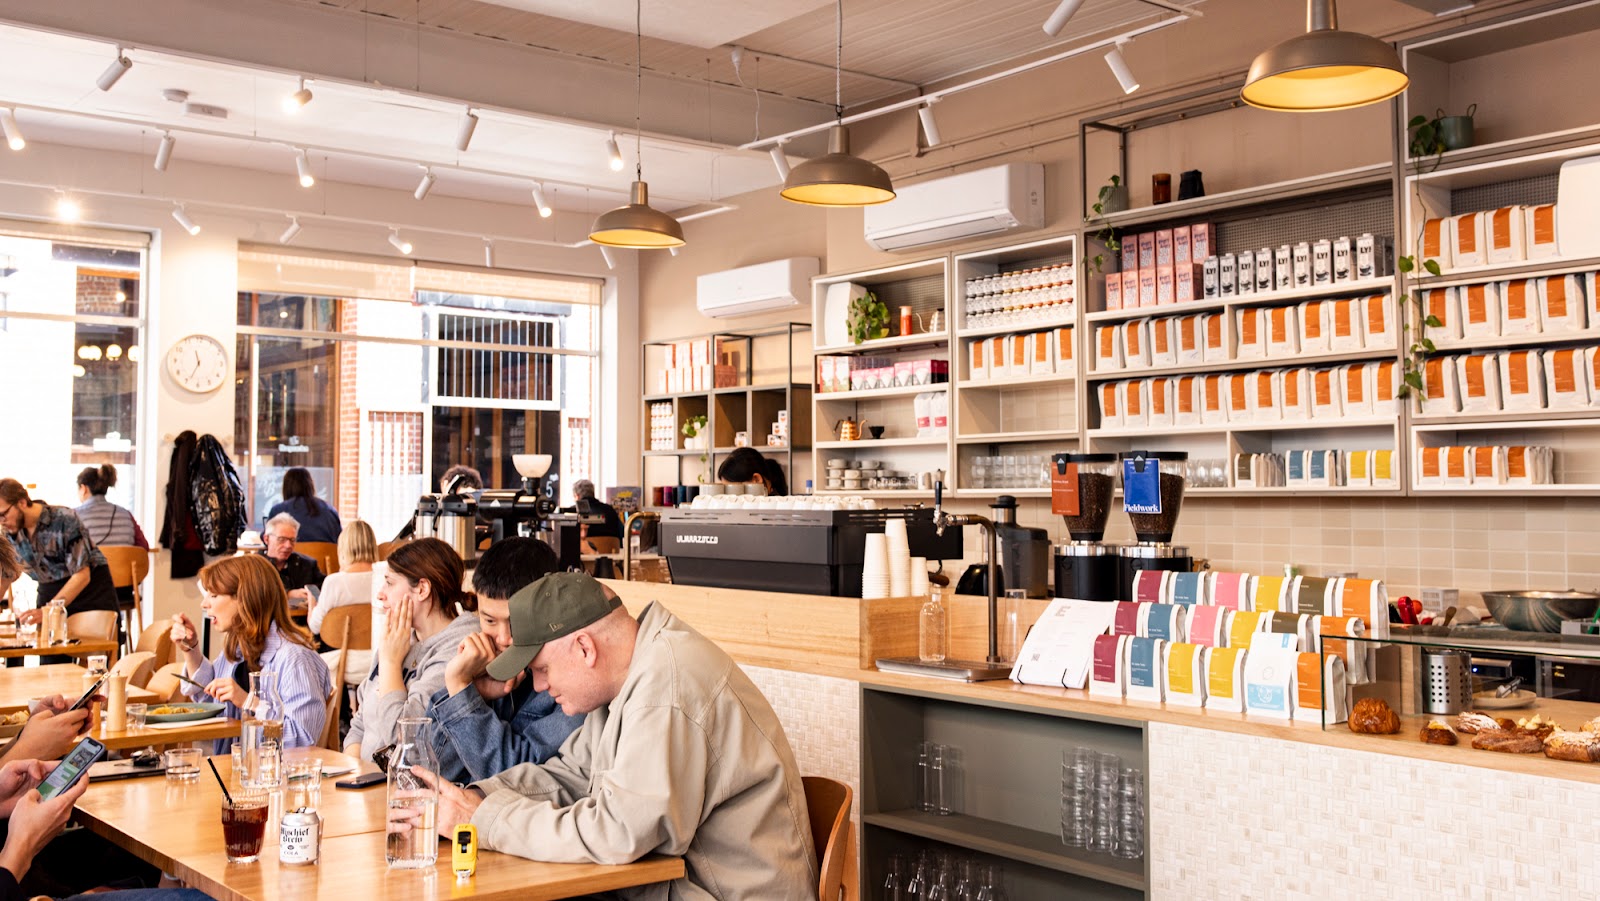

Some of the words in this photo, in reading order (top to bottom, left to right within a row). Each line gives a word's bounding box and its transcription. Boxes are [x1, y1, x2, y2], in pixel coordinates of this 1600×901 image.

[545, 480, 554, 498] 5
[1124, 504, 1159, 512] Fieldwork
[280, 827, 310, 837] Mischief
[283, 834, 303, 843] Brew
